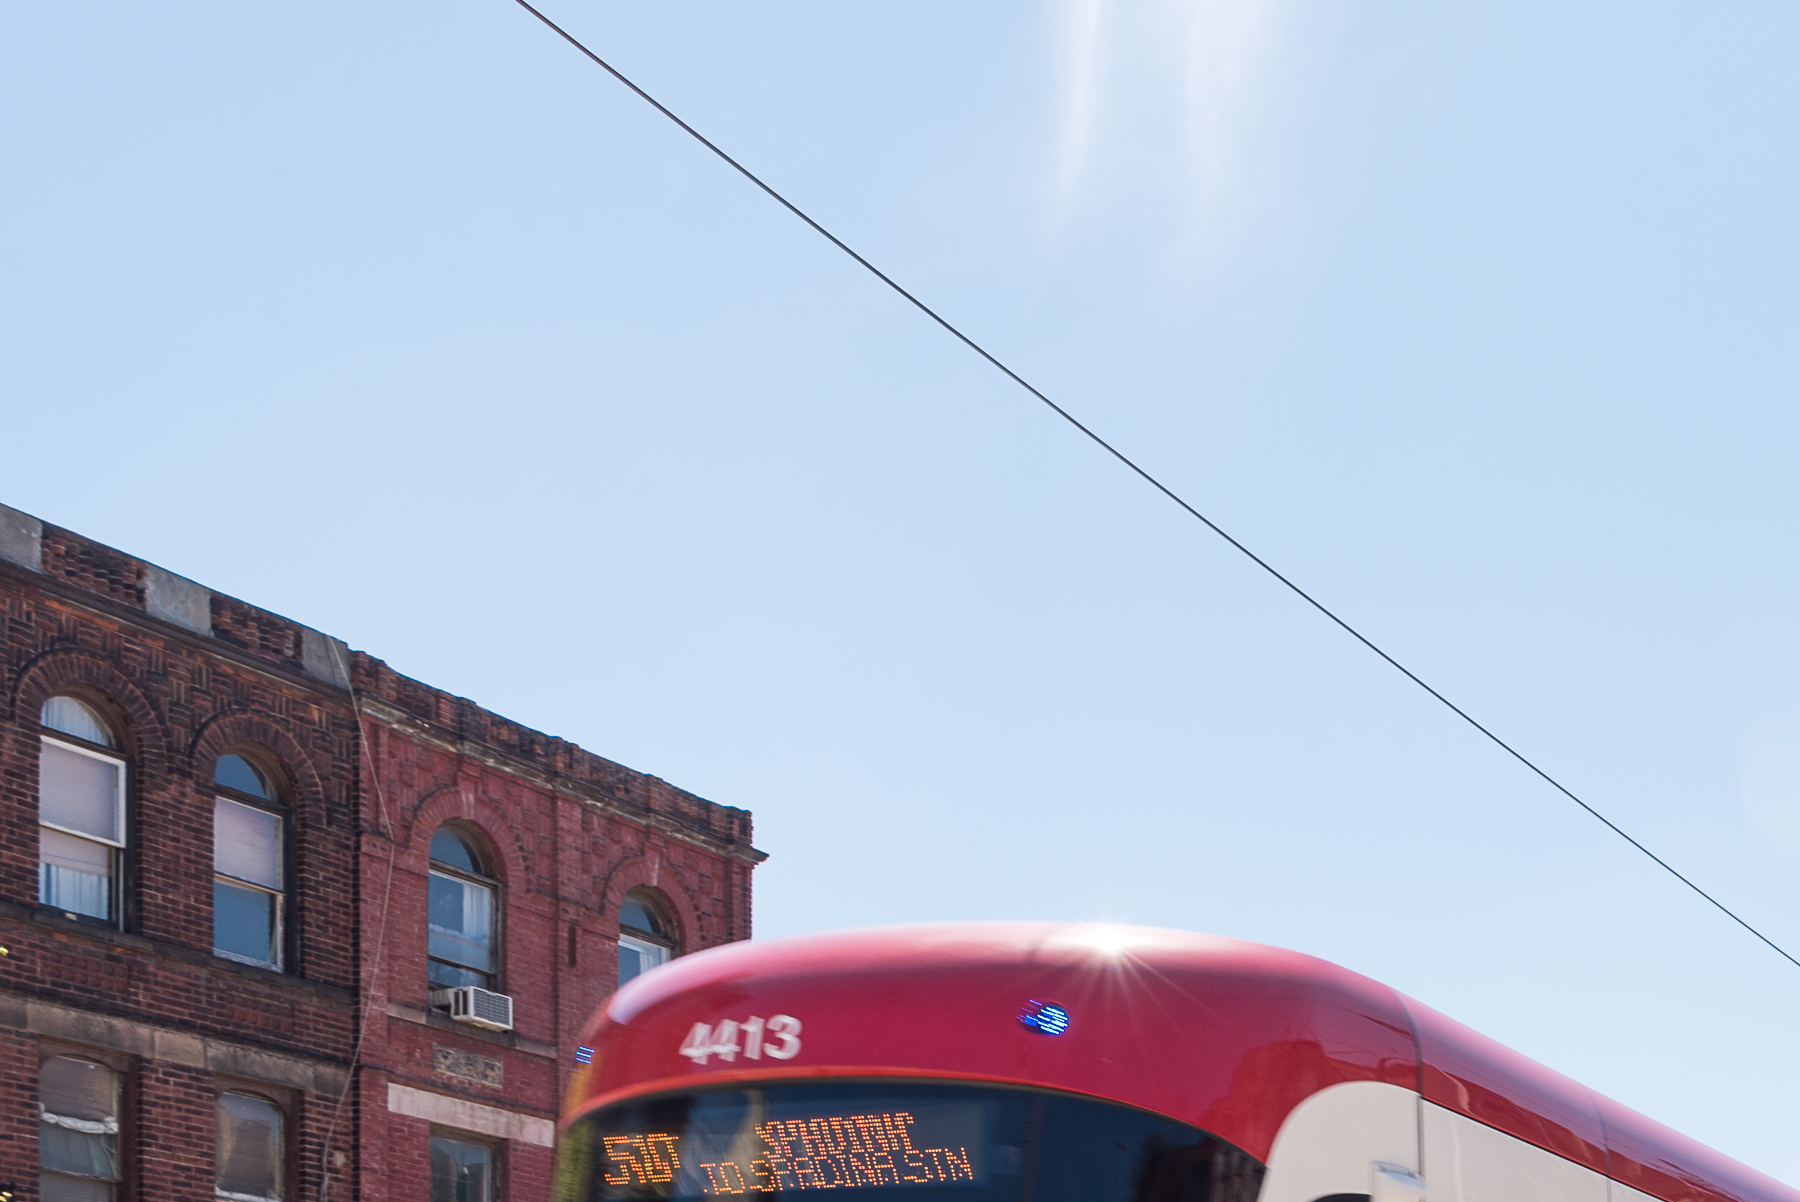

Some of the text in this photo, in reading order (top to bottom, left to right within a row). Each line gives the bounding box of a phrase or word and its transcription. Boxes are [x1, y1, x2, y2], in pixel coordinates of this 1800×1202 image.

[679, 1013, 803, 1064] 4413
[602, 1133, 681, 1186] 510
[749, 1150, 899, 1192] SPADINA
[902, 1146, 974, 1182] STN
